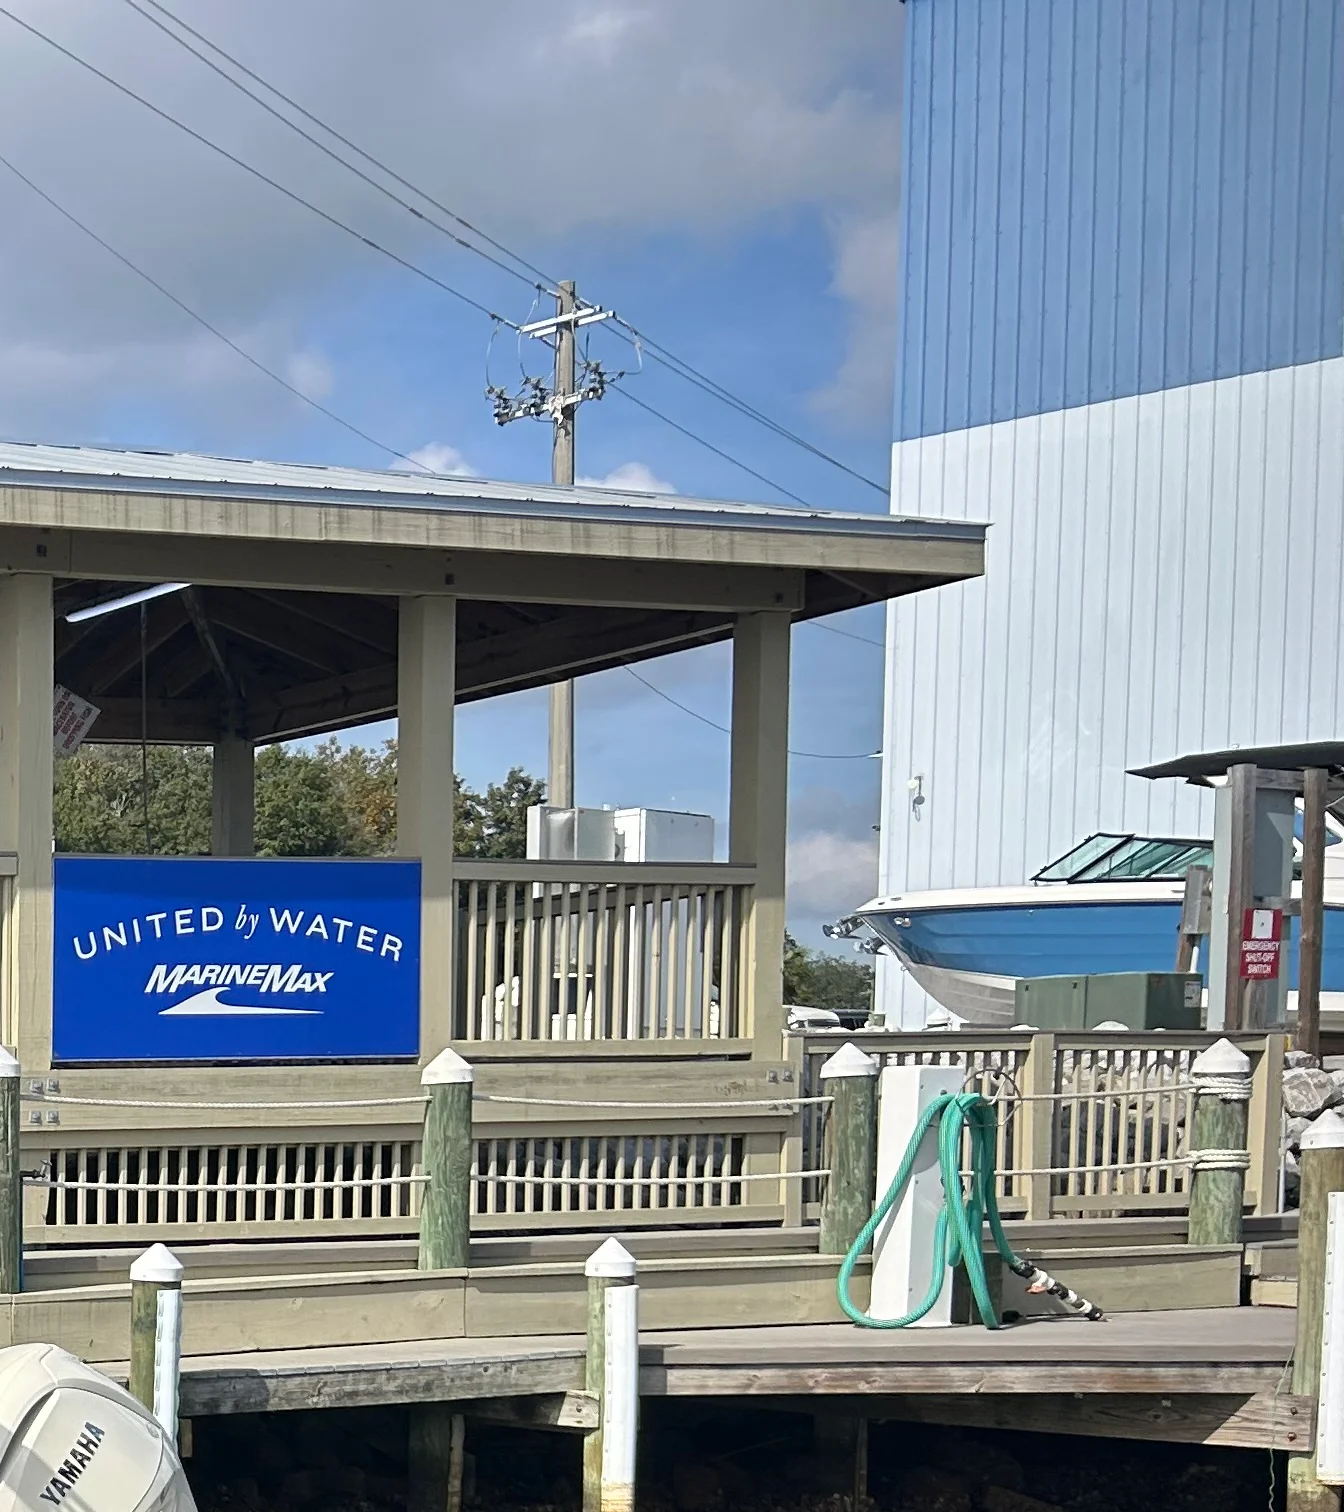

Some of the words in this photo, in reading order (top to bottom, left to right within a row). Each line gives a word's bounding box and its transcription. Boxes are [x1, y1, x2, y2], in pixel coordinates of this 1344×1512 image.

[73, 907, 224, 960] UNITED
[234, 904, 260, 940] by
[268, 907, 404, 962] WATER
[1242, 940, 1280, 951] EMERGENCY
[1247, 963, 1272, 974] SWITCH
[39, 1421, 105, 1506] YAMAHA
